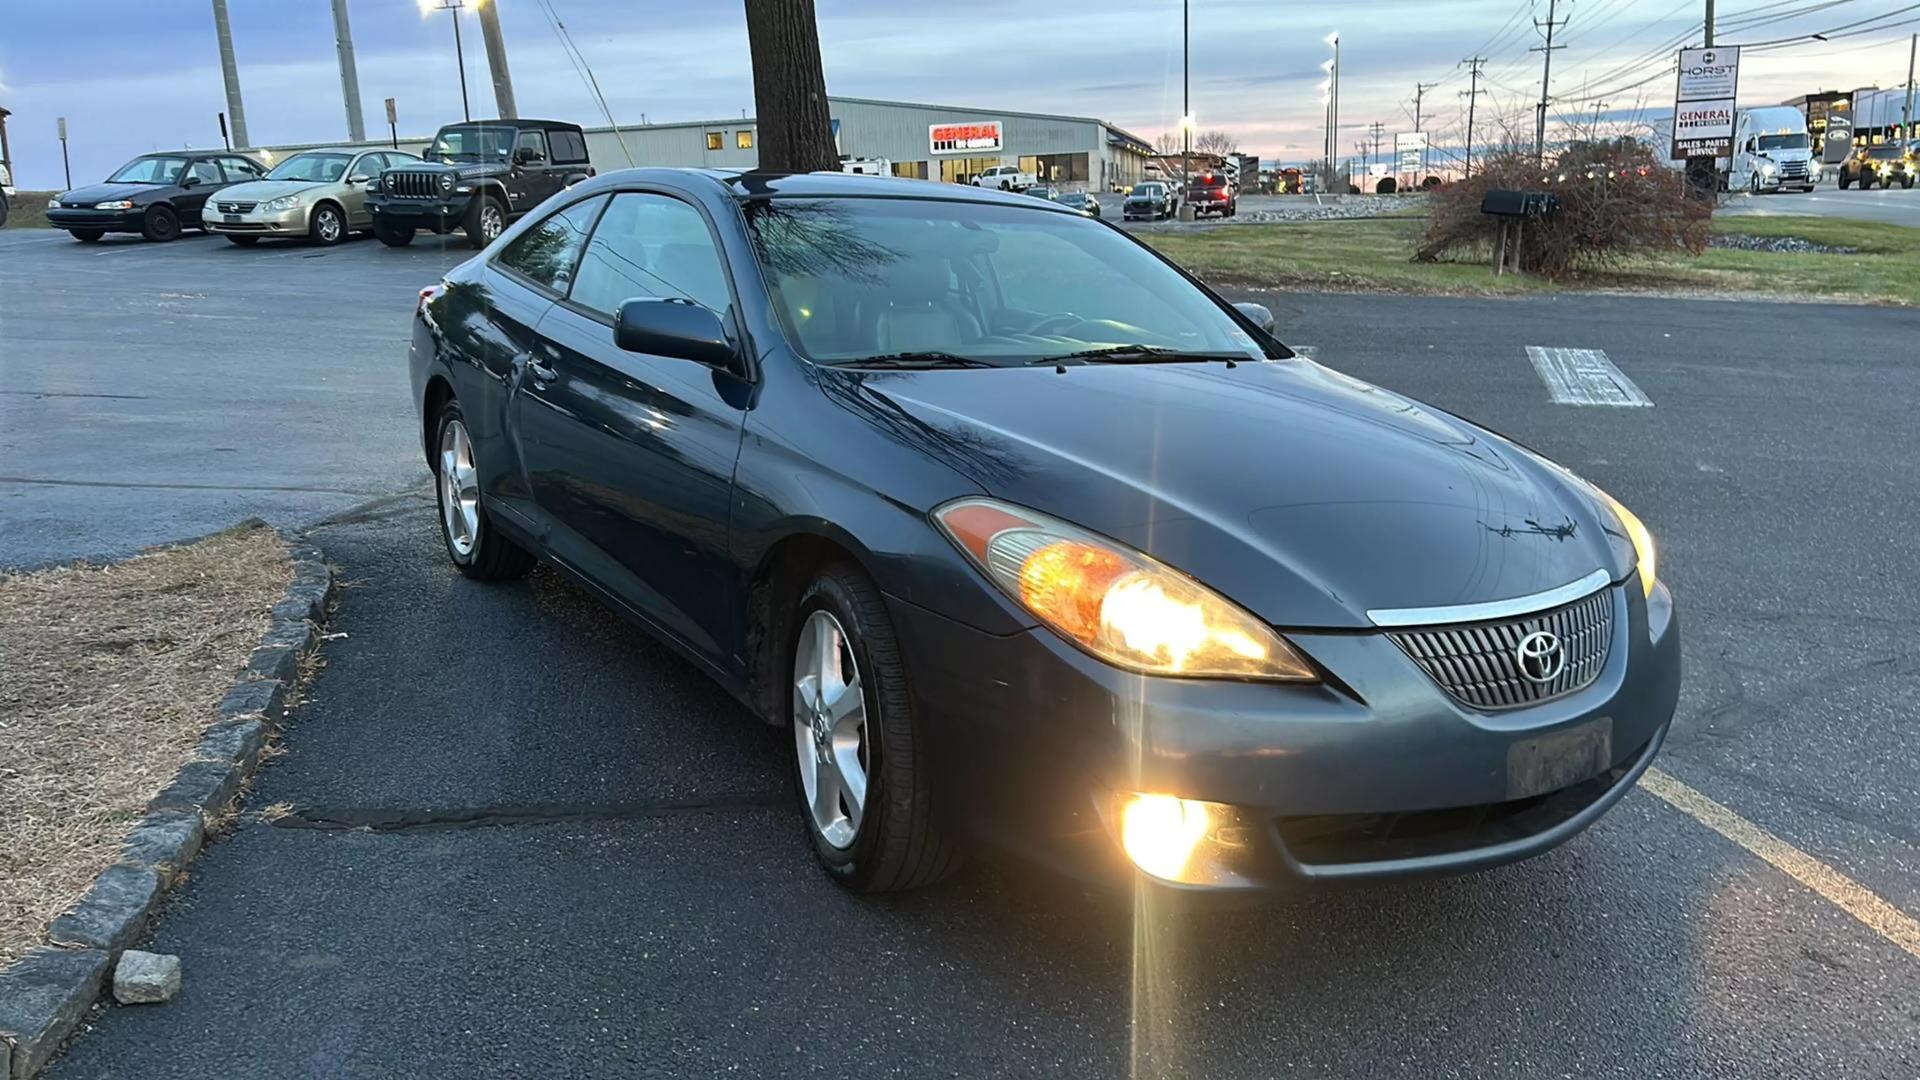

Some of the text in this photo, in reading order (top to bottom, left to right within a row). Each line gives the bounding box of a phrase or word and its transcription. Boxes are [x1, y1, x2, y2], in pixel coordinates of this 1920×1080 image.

[1680, 65, 1736, 76] HORST
[1680, 110, 1731, 121] GENERAL
[933, 125, 999, 141] GENERAL
[1687, 148, 1718, 156] SERVICE
